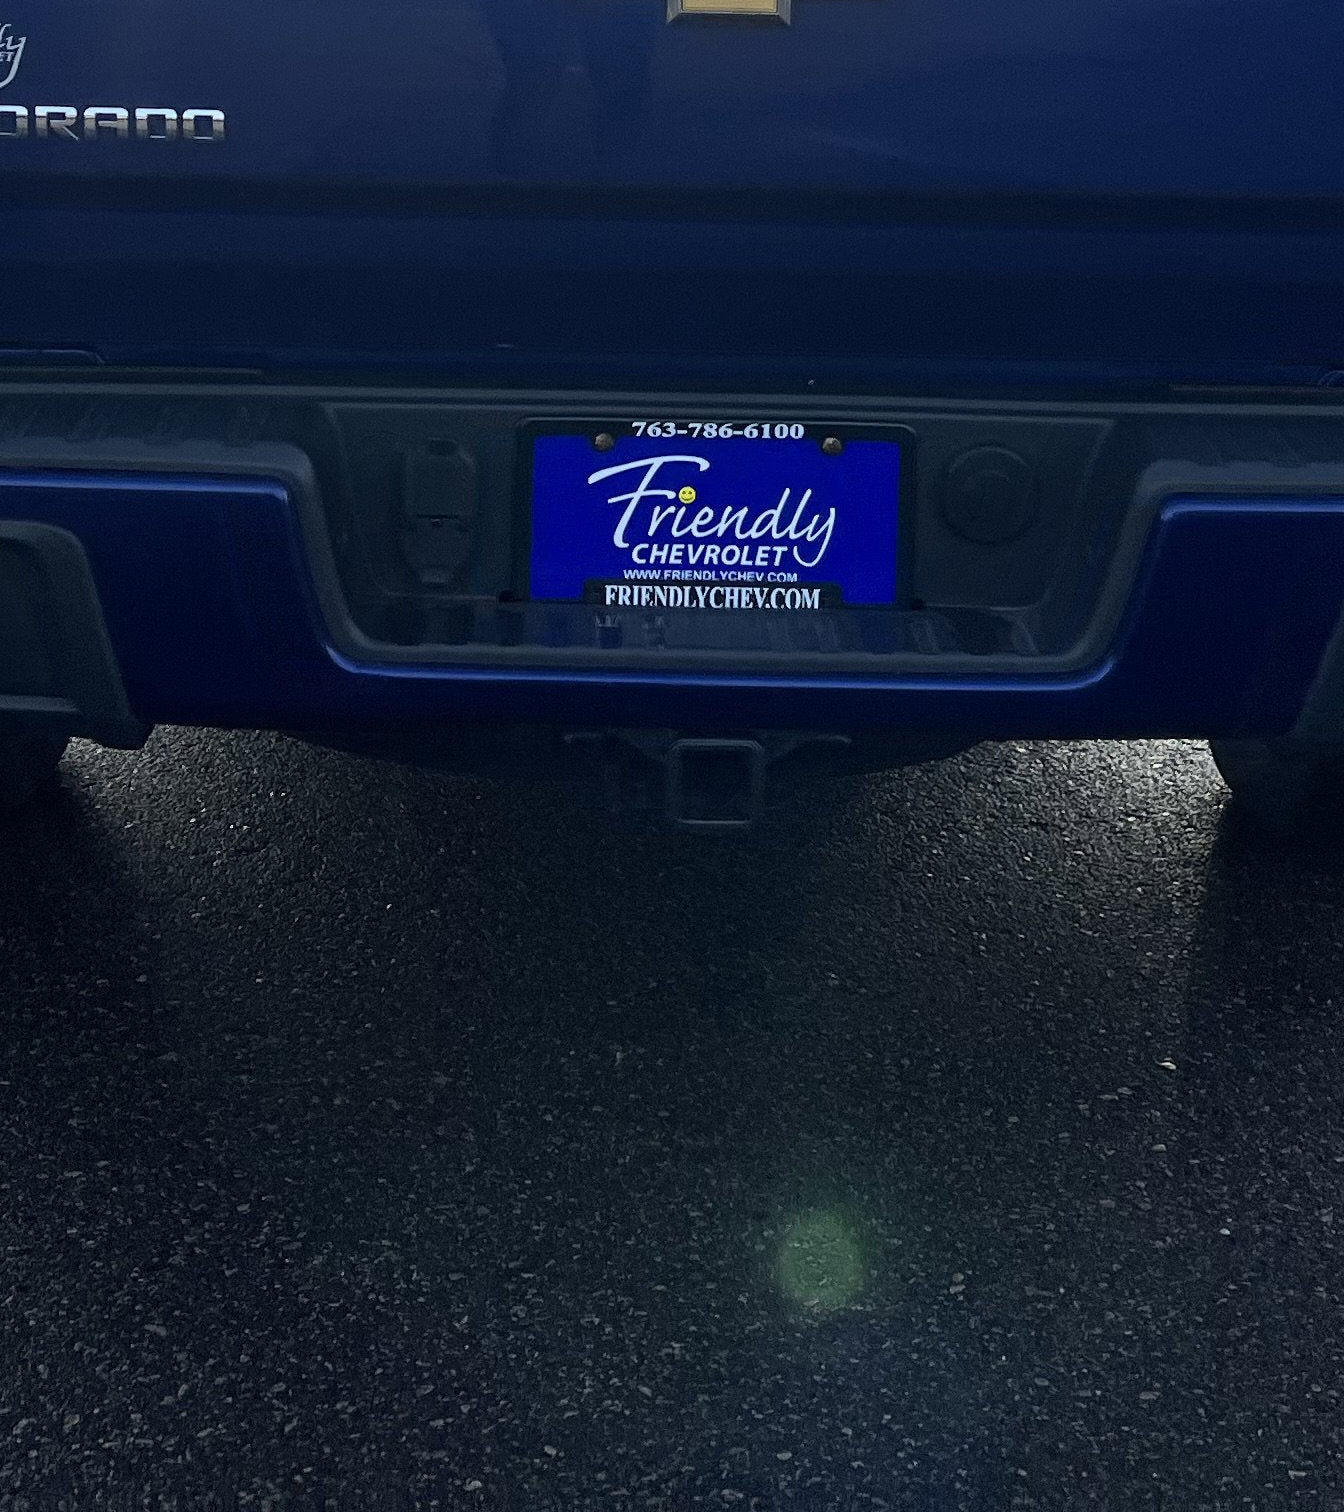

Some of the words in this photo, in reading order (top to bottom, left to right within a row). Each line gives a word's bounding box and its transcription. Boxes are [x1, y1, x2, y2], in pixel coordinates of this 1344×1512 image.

[632, 421, 805, 440] 763-786-6100
[587, 455, 836, 568] Friendly
[631, 543, 788, 567] CHEVROLET
[623, 569, 798, 583] WWW.FRIENDLYCHEV.COM
[605, 584, 821, 610] FRIENDLYCHEV.COM
